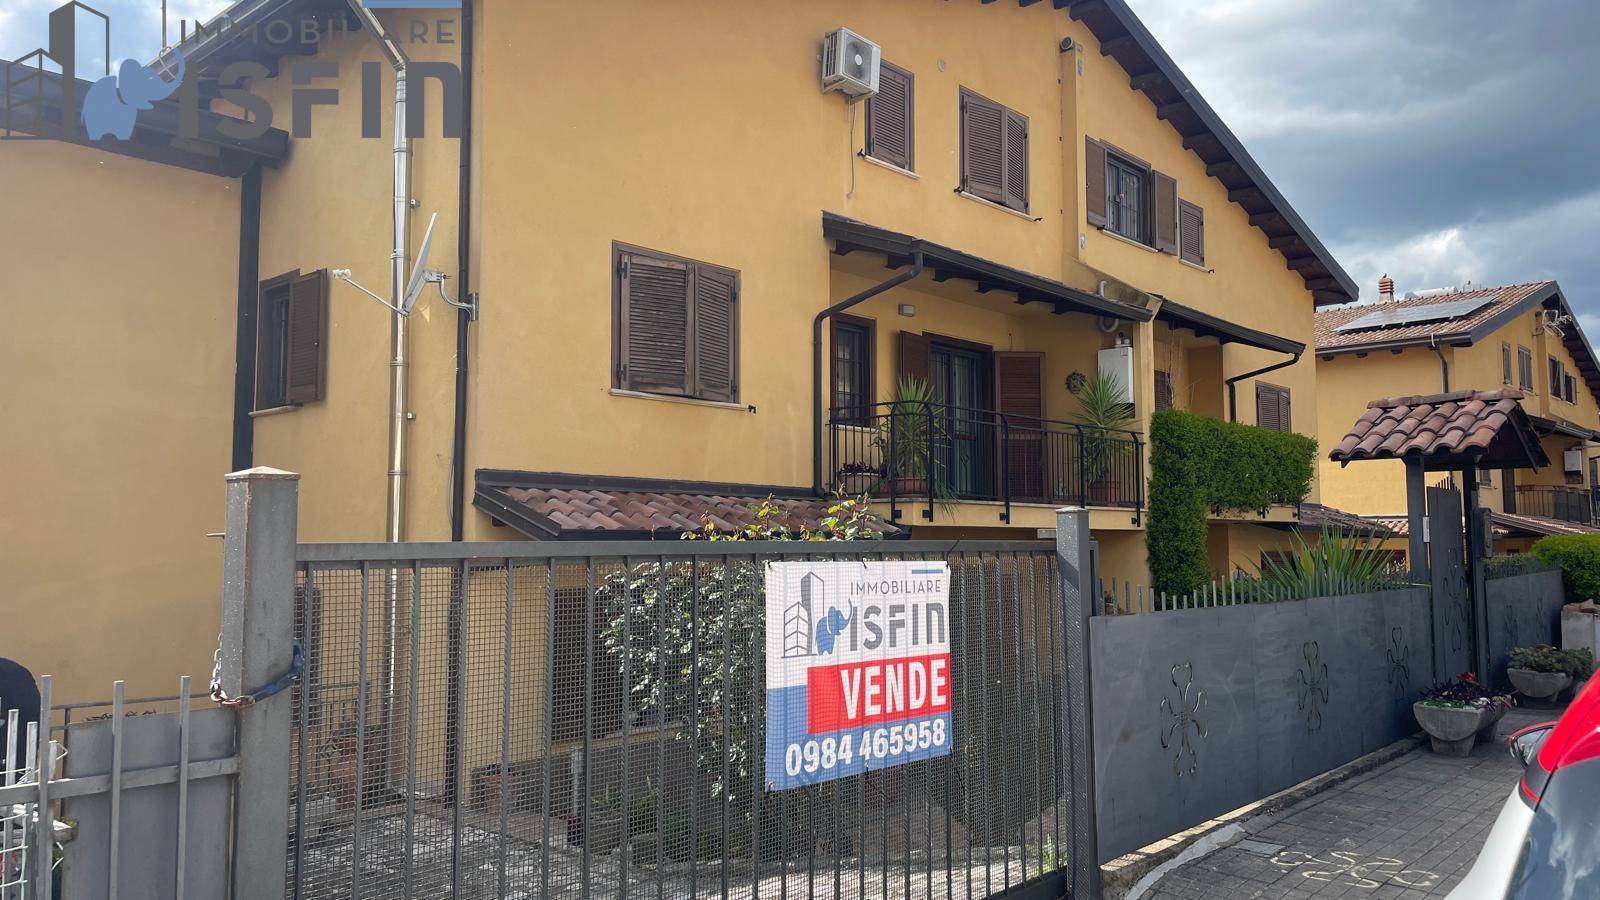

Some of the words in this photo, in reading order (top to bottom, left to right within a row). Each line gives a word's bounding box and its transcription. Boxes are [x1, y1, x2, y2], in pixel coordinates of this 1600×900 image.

[850, 579, 941, 595] IMMOBILIARE
[841, 659, 946, 720] VENDE
[785, 734, 853, 776] 0984
[859, 718, 946, 760] 465958
